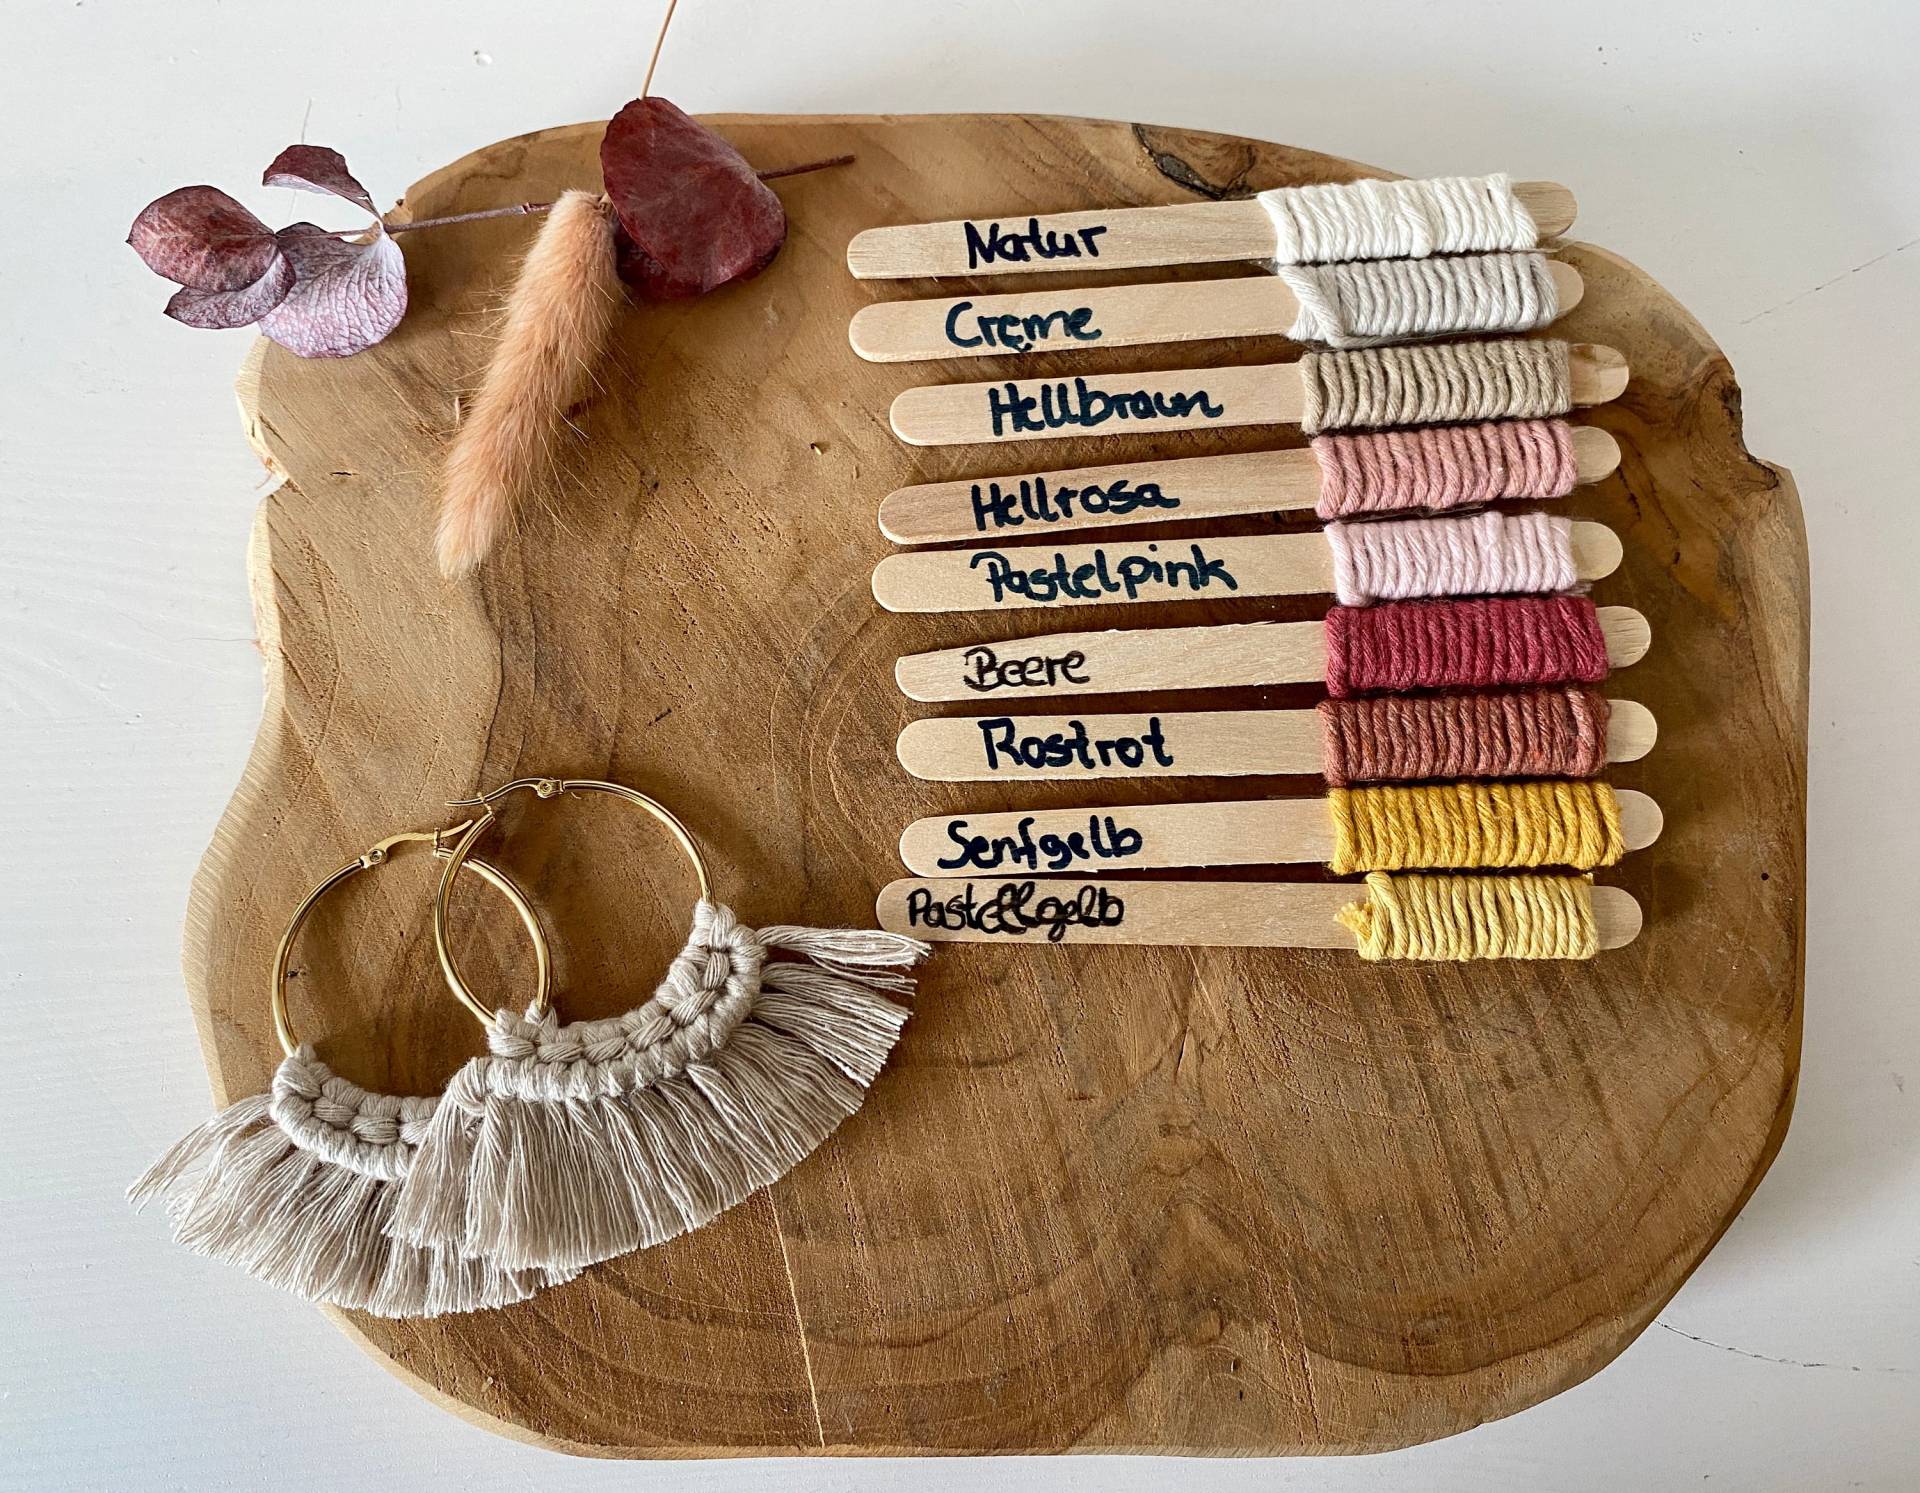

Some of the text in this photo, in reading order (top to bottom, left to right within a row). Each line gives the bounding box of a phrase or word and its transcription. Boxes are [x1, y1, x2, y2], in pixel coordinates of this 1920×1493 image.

[964, 217, 1107, 269] Natur
[987, 377, 1224, 437] Hellbraun
[970, 476, 1181, 531] Hellrosa
[969, 544, 1239, 602] Pastelpink
[962, 645, 1091, 693] Beere
[977, 716, 1174, 770] Rostrot
[936, 814, 1144, 871] Senfgelb
[906, 880, 1125, 943] Pastellgelb
